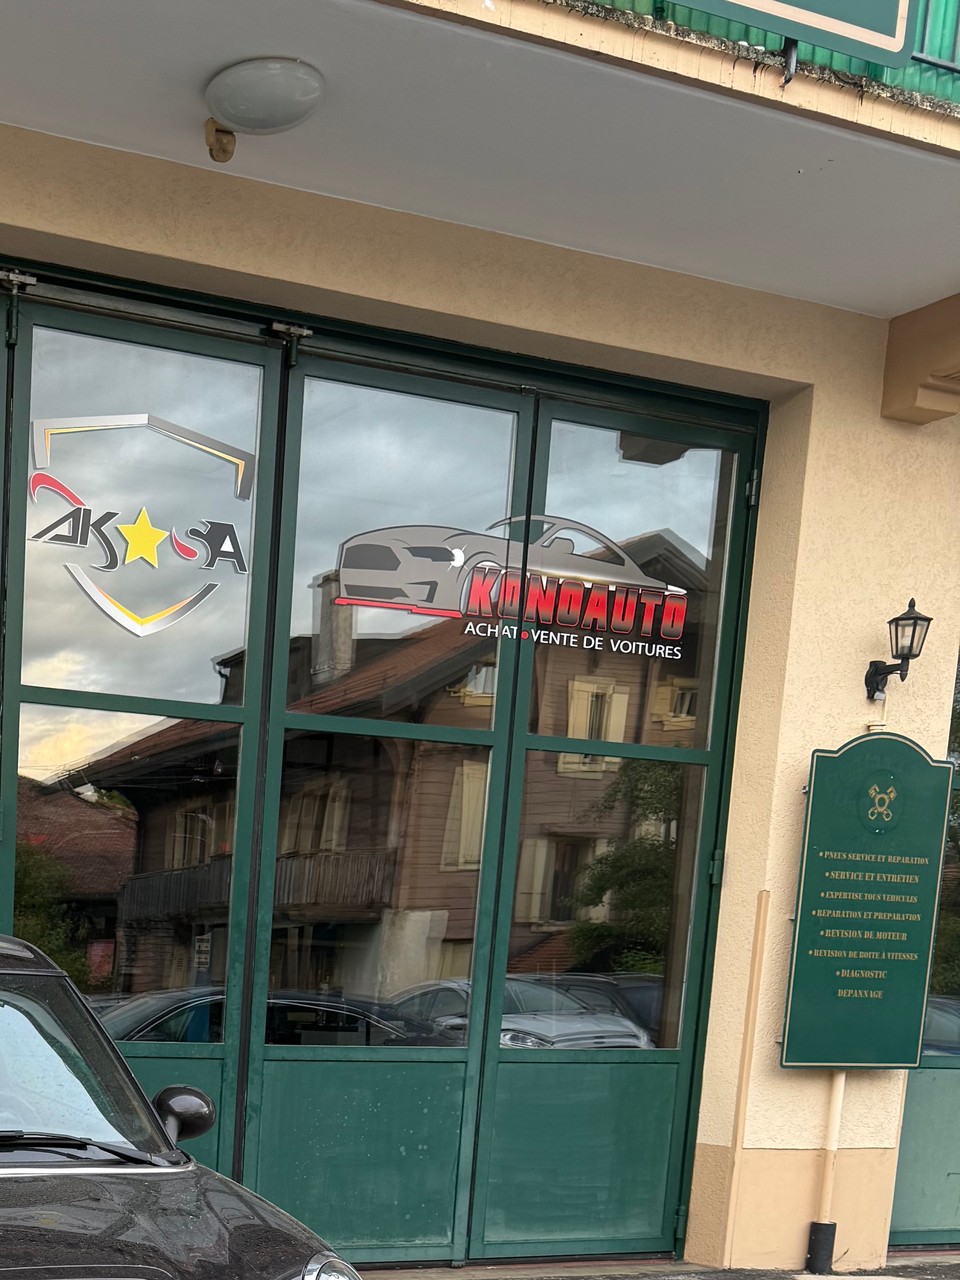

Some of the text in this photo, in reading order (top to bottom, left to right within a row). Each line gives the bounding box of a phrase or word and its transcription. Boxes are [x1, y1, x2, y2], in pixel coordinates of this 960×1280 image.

[466, 567, 687, 640] KONOAUTO
[464, 622, 681, 659] ACHAT VENTE DE VOITURES
[847, 853, 876, 862] SERVICE
[830, 871, 919, 883] SERVICE ET ENTRETIEN
[825, 891, 862, 900] EXPERTISE
[864, 893, 881, 901] TOUS
[863, 911, 873, 919] ET
[864, 931, 874, 939] DE
[876, 931, 907, 940] MOTEUR
[848, 950, 858, 959] DE
[887, 952, 918, 960] VITESSES
[841, 969, 887, 979] DIAGNOSTIC
